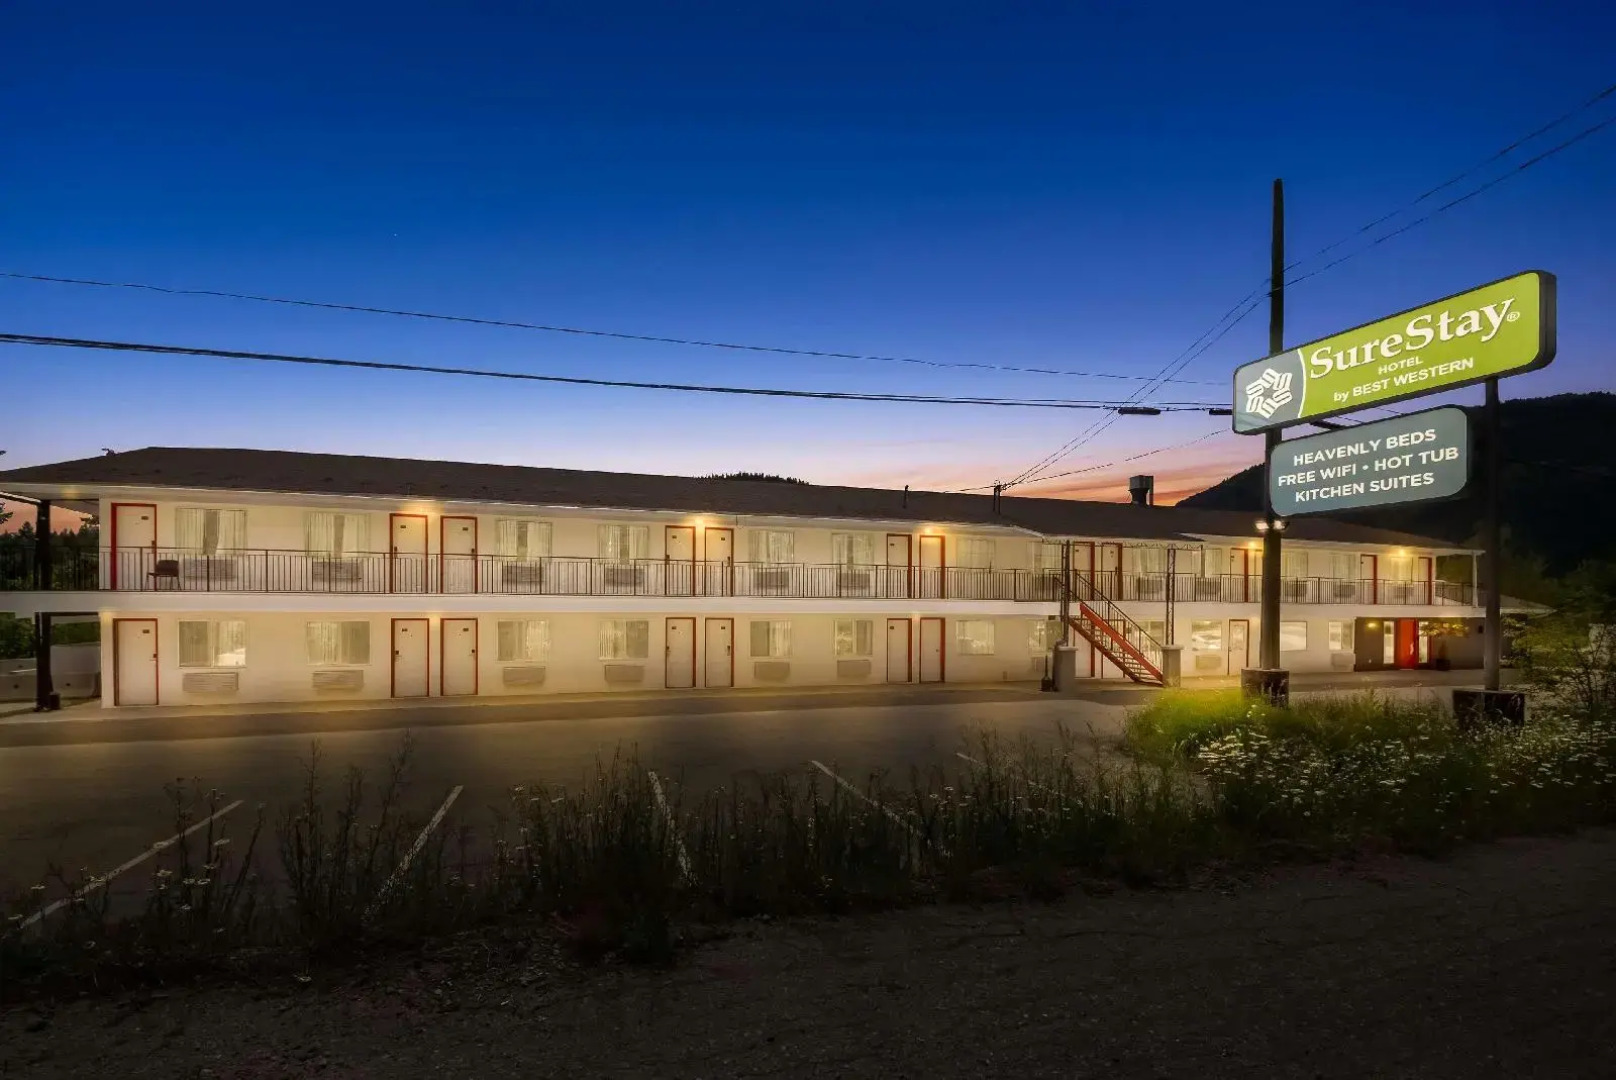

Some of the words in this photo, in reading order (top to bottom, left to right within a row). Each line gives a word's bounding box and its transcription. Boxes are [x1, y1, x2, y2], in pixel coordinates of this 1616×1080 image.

[1333, 391, 1349, 403] by
[1353, 379, 1388, 397] BEST
[1394, 358, 1474, 387] WESTERN
[1378, 356, 1423, 375] HOTEL
[1293, 439, 1382, 466] HEAVENLY
[1386, 429, 1436, 449] BEDS
[1278, 471, 1315, 487] FREE
[1320, 463, 1356, 482] WIFI
[1374, 454, 1415, 472] HOT
[1418, 447, 1459, 465] TUB
[1295, 483, 1364, 503] KITCHEN
[1370, 473, 1435, 492] SUITES
